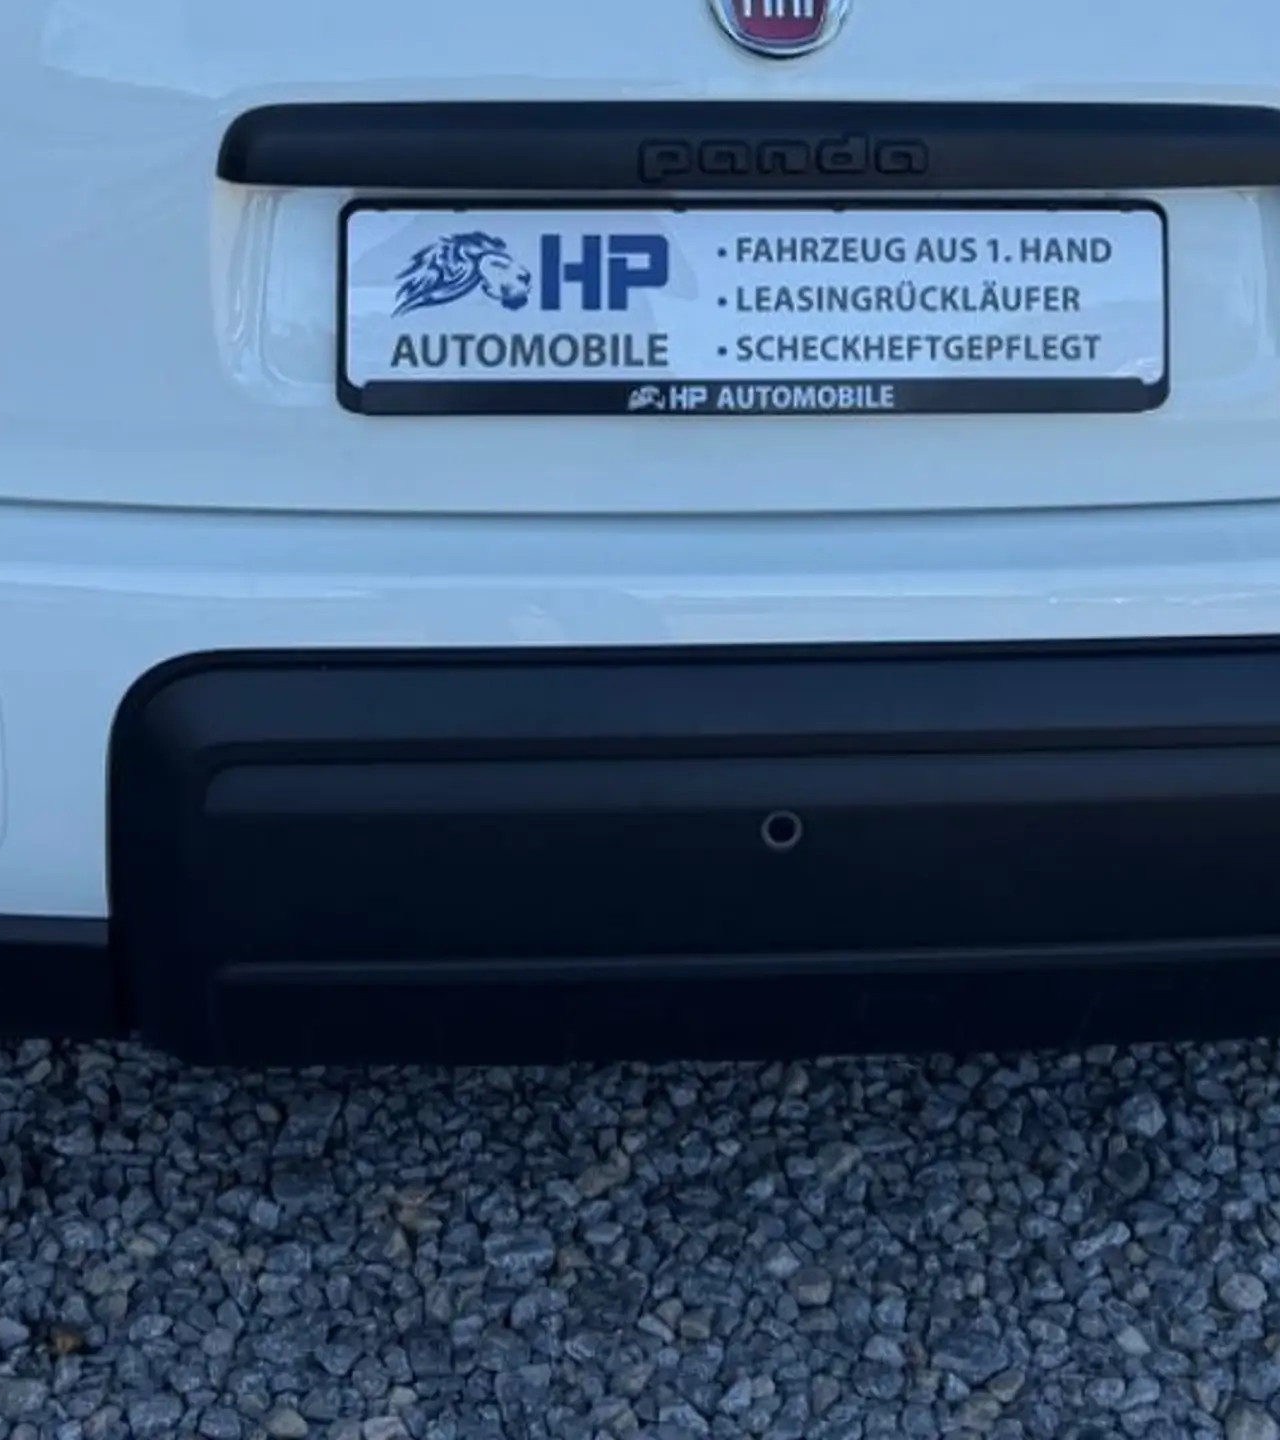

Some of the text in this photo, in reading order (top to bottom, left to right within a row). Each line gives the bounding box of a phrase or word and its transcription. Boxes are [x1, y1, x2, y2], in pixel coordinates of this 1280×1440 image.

[637, 134, 930, 183] panda
[736, 237, 1113, 263] FAHRZEUG AUS 1. HAND
[539, 234, 669, 311] HP
[736, 280, 1080, 312] LEASINGRÜCKLÄUFER
[390, 333, 668, 368] AUTOMOBILE
[736, 335, 1101, 361] SCHECKHEFTGEPFLEGT
[670, 385, 894, 409] HP AUTOMOBILE
